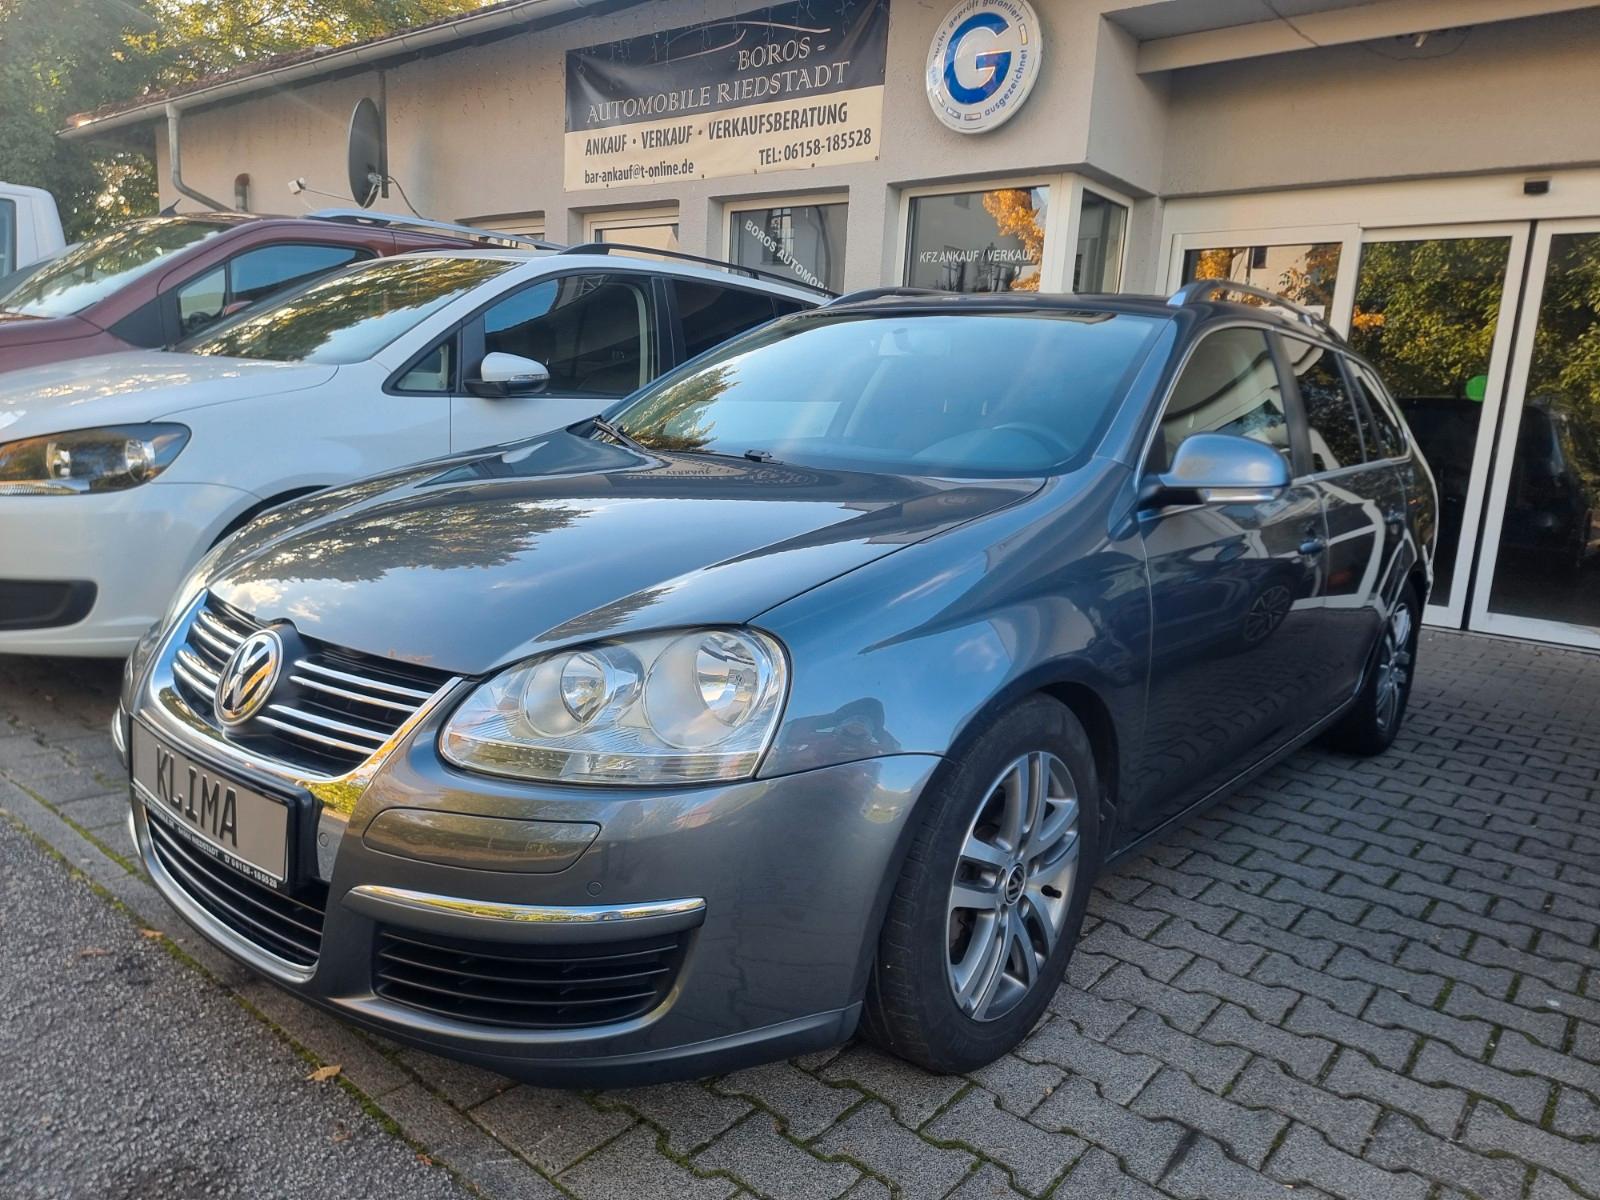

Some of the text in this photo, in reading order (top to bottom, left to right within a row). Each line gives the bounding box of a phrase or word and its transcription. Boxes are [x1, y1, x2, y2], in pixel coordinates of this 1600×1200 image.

[982, 0, 1023, 22] garantiert
[738, 36, 811, 71] BOROS
[942, 11, 1012, 106] G
[585, 60, 850, 124] AUTOMOBILE RIEDSTADT
[984, 49, 1028, 116] ausgezeichnet
[585, 102, 848, 156] ANKAUF VERKAUF VERKAUFSBERATUNG
[784, 127, 872, 161] 06158-185528
[584, 158, 694, 184] bar-ankauf@t-online.de
[744, 220, 830, 291] BOROS AUTOMO
[919, 251, 938, 263] KFZ
[940, 250, 979, 262] ANKAUF
[987, 249, 1036, 261] VERKAUF
[156, 744, 239, 849] KLIMA
